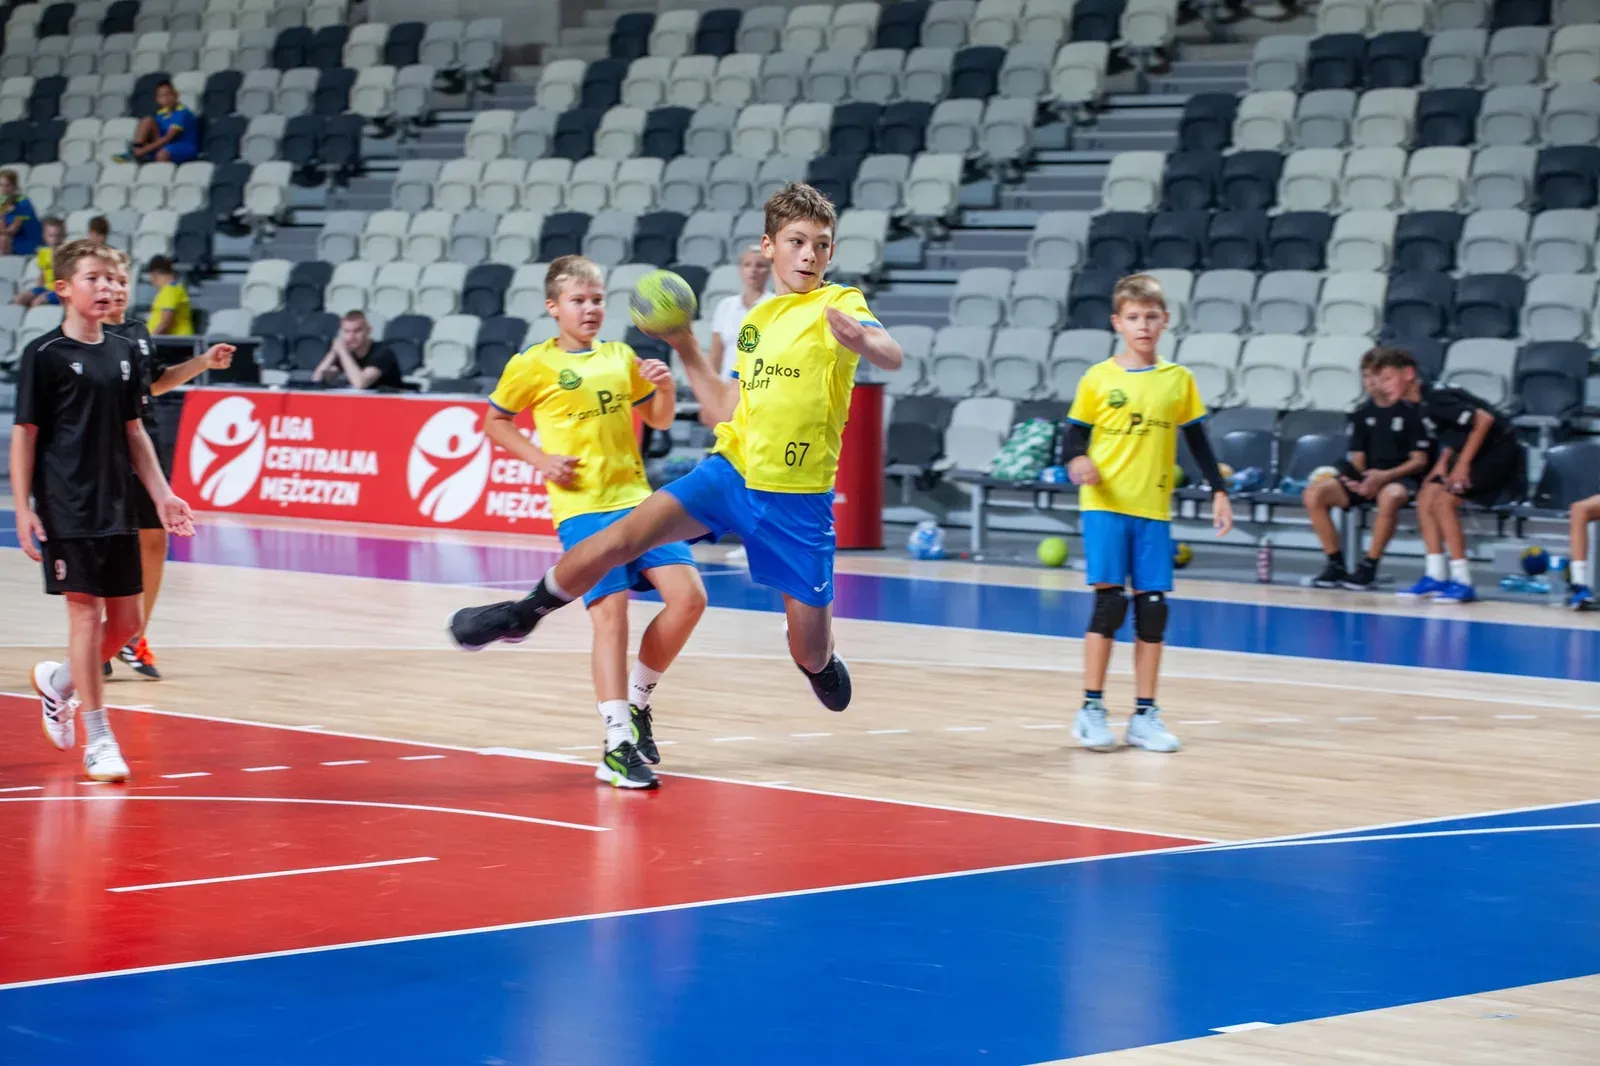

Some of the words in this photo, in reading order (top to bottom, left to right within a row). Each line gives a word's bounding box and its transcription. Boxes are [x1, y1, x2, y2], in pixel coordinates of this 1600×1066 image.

[269, 414, 315, 441] LIGA
[264, 445, 379, 476] CENTRALNA
[784, 441, 811, 467] 67
